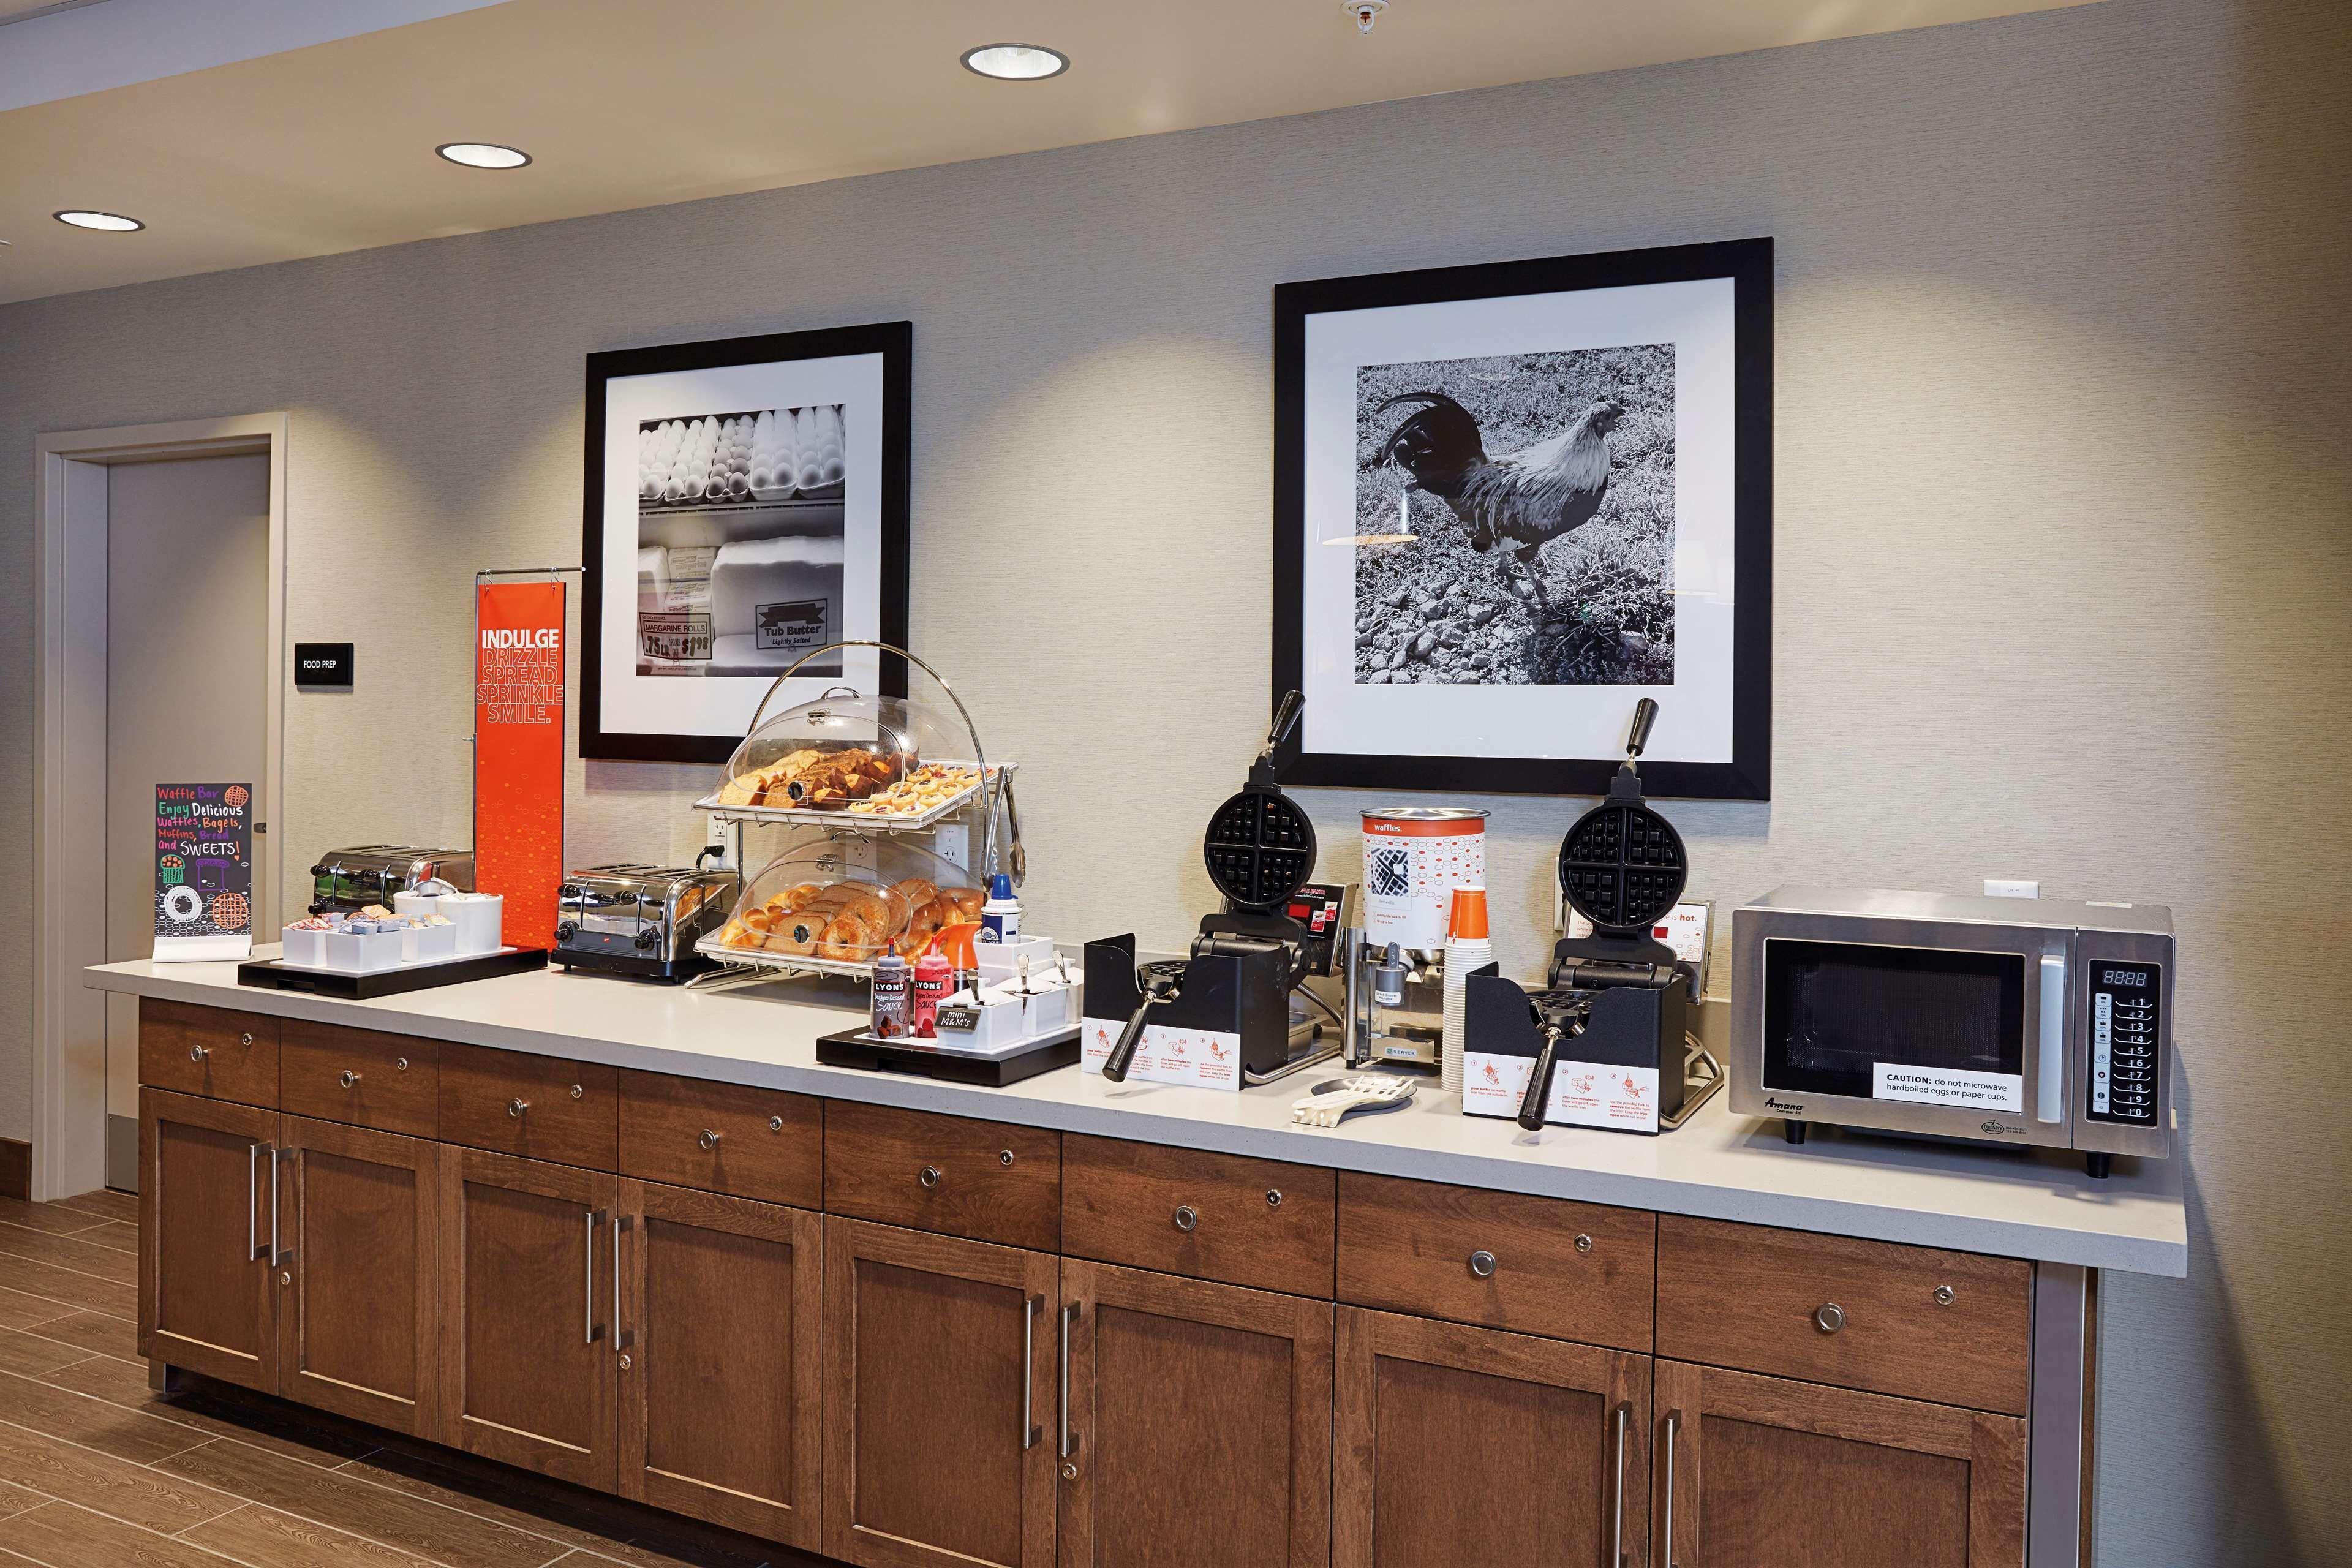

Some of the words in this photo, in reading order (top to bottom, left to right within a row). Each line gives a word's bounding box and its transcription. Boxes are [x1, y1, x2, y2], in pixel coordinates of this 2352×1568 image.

[765, 627, 784, 636] Tub
[787, 625, 821, 635] Butter
[482, 629, 559, 648] INDULGE
[484, 647, 557, 666] DRIZZLE
[303, 660, 321, 668] FOOD
[322, 660, 336, 668] PREP
[482, 666, 557, 686] SPREAD
[477, 685, 563, 704] SPRINKLE
[488, 704, 551, 723] SMILE.
[157, 787, 195, 799] Waffle
[198, 786, 219, 798] Bar
[159, 802, 189, 819] Enjoy
[192, 803, 243, 816] Delicious
[200, 829, 229, 839] Bread
[159, 840, 176, 850] and
[180, 841, 240, 860] SWEETS!
[876, 1000, 902, 1012] Sauce
[948, 1011, 965, 1019] mini
[941, 1017, 970, 1027] M&M's
[1887, 1074, 1931, 1084] CAUTION:
[1964, 1081, 2007, 1091] microwave
[1887, 1083, 1928, 1093] hardboiled
[1764, 1097, 1803, 1110] Amana
